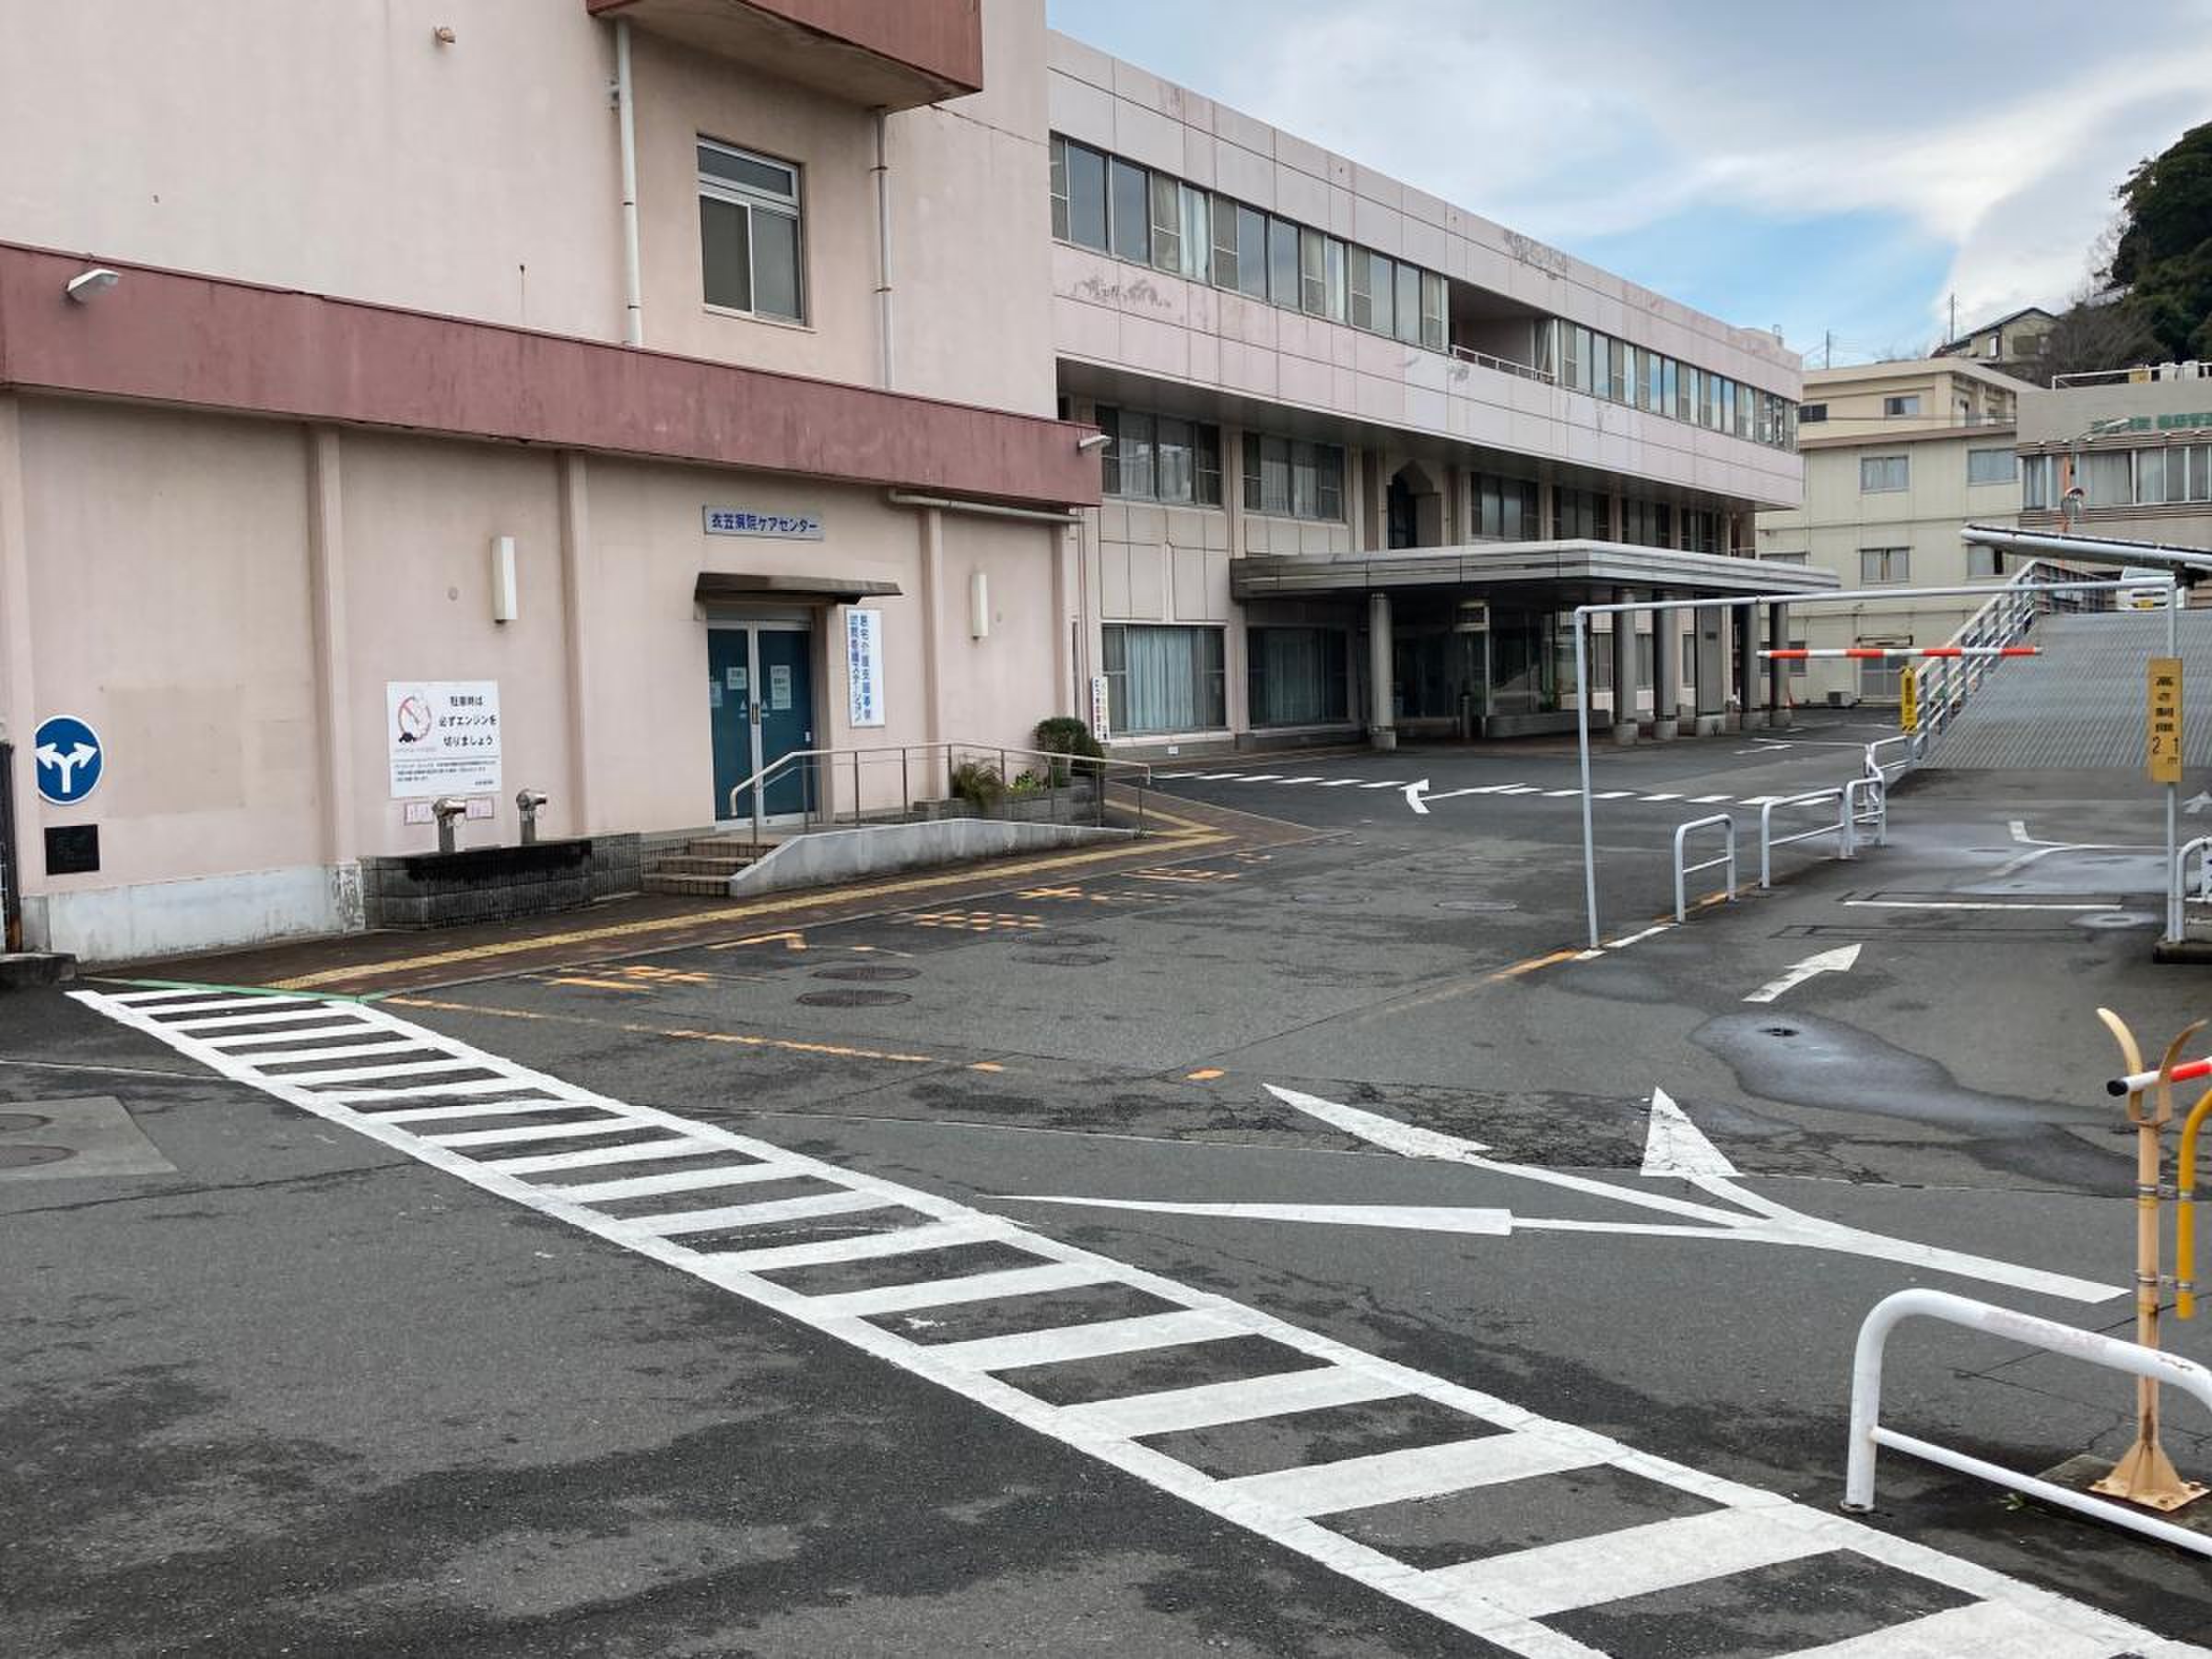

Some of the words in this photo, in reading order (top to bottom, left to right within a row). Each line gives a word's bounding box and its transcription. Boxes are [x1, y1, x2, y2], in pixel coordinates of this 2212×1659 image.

[443, 735, 493, 747] 切りましょう
